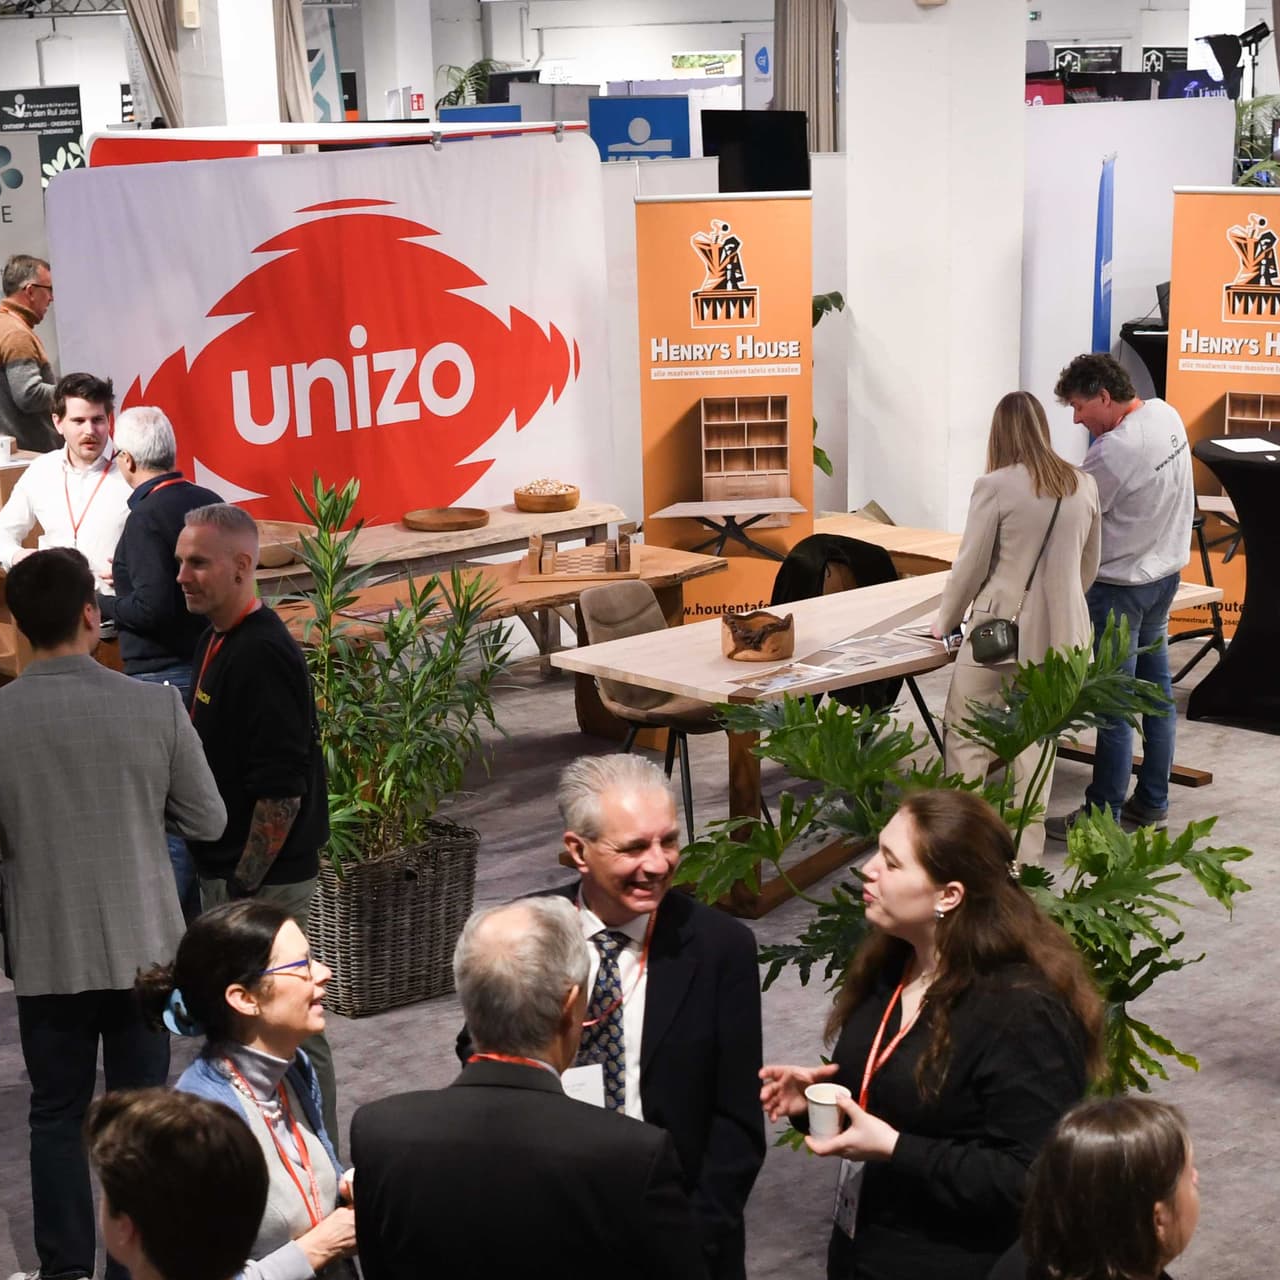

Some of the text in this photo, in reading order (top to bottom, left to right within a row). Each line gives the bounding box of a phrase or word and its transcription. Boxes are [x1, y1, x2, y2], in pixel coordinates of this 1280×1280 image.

[650, 334, 801, 363] HENRY'S HOUSE
[1180, 328, 1260, 356] HENRY'S
[230, 323, 475, 446] unizo
